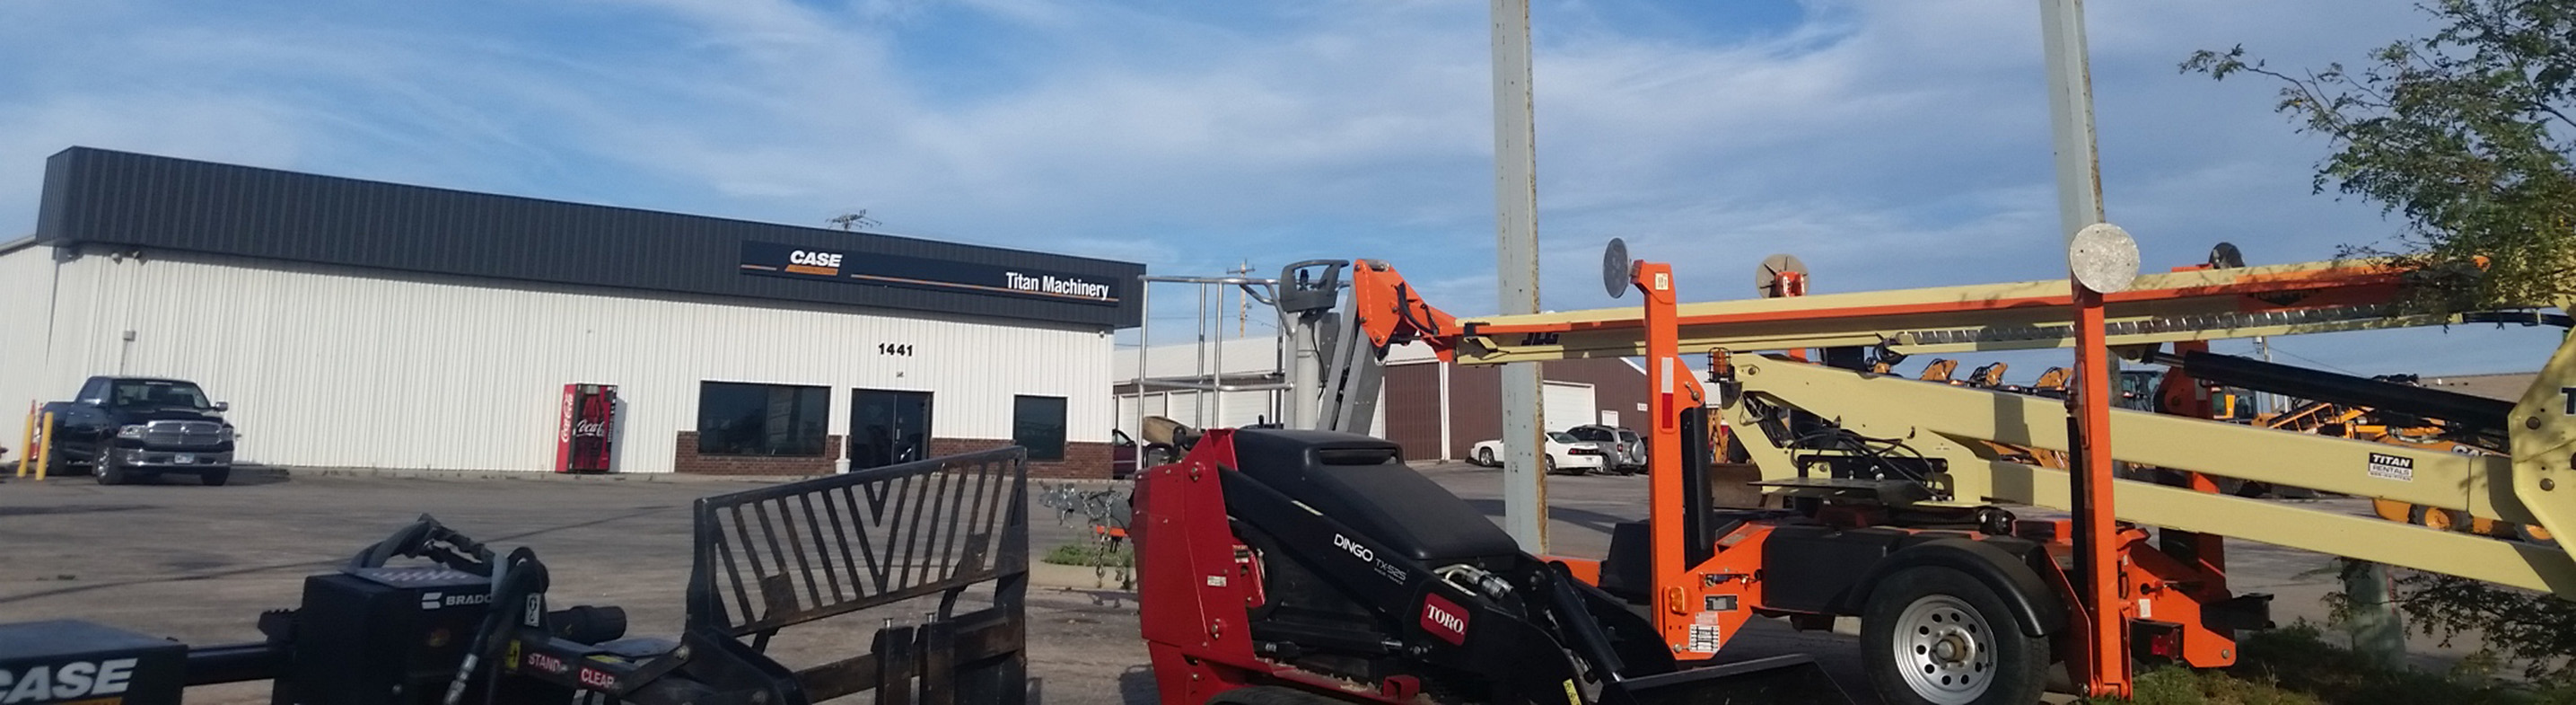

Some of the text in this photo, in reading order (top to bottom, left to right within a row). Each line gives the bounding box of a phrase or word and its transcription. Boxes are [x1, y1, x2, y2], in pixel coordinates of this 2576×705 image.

[790, 250, 843, 268] CASE
[1006, 271, 1109, 301] Titan Machinery
[1520, 331, 1559, 347] JLG
[878, 342, 913, 357] 1441
[2372, 464, 2410, 475] RENTALS
[2373, 454, 2411, 467] TITAN
[1334, 533, 1374, 562] DINGO
[1427, 604, 1464, 634] TORO
[528, 653, 615, 689] STAND CLEAR
